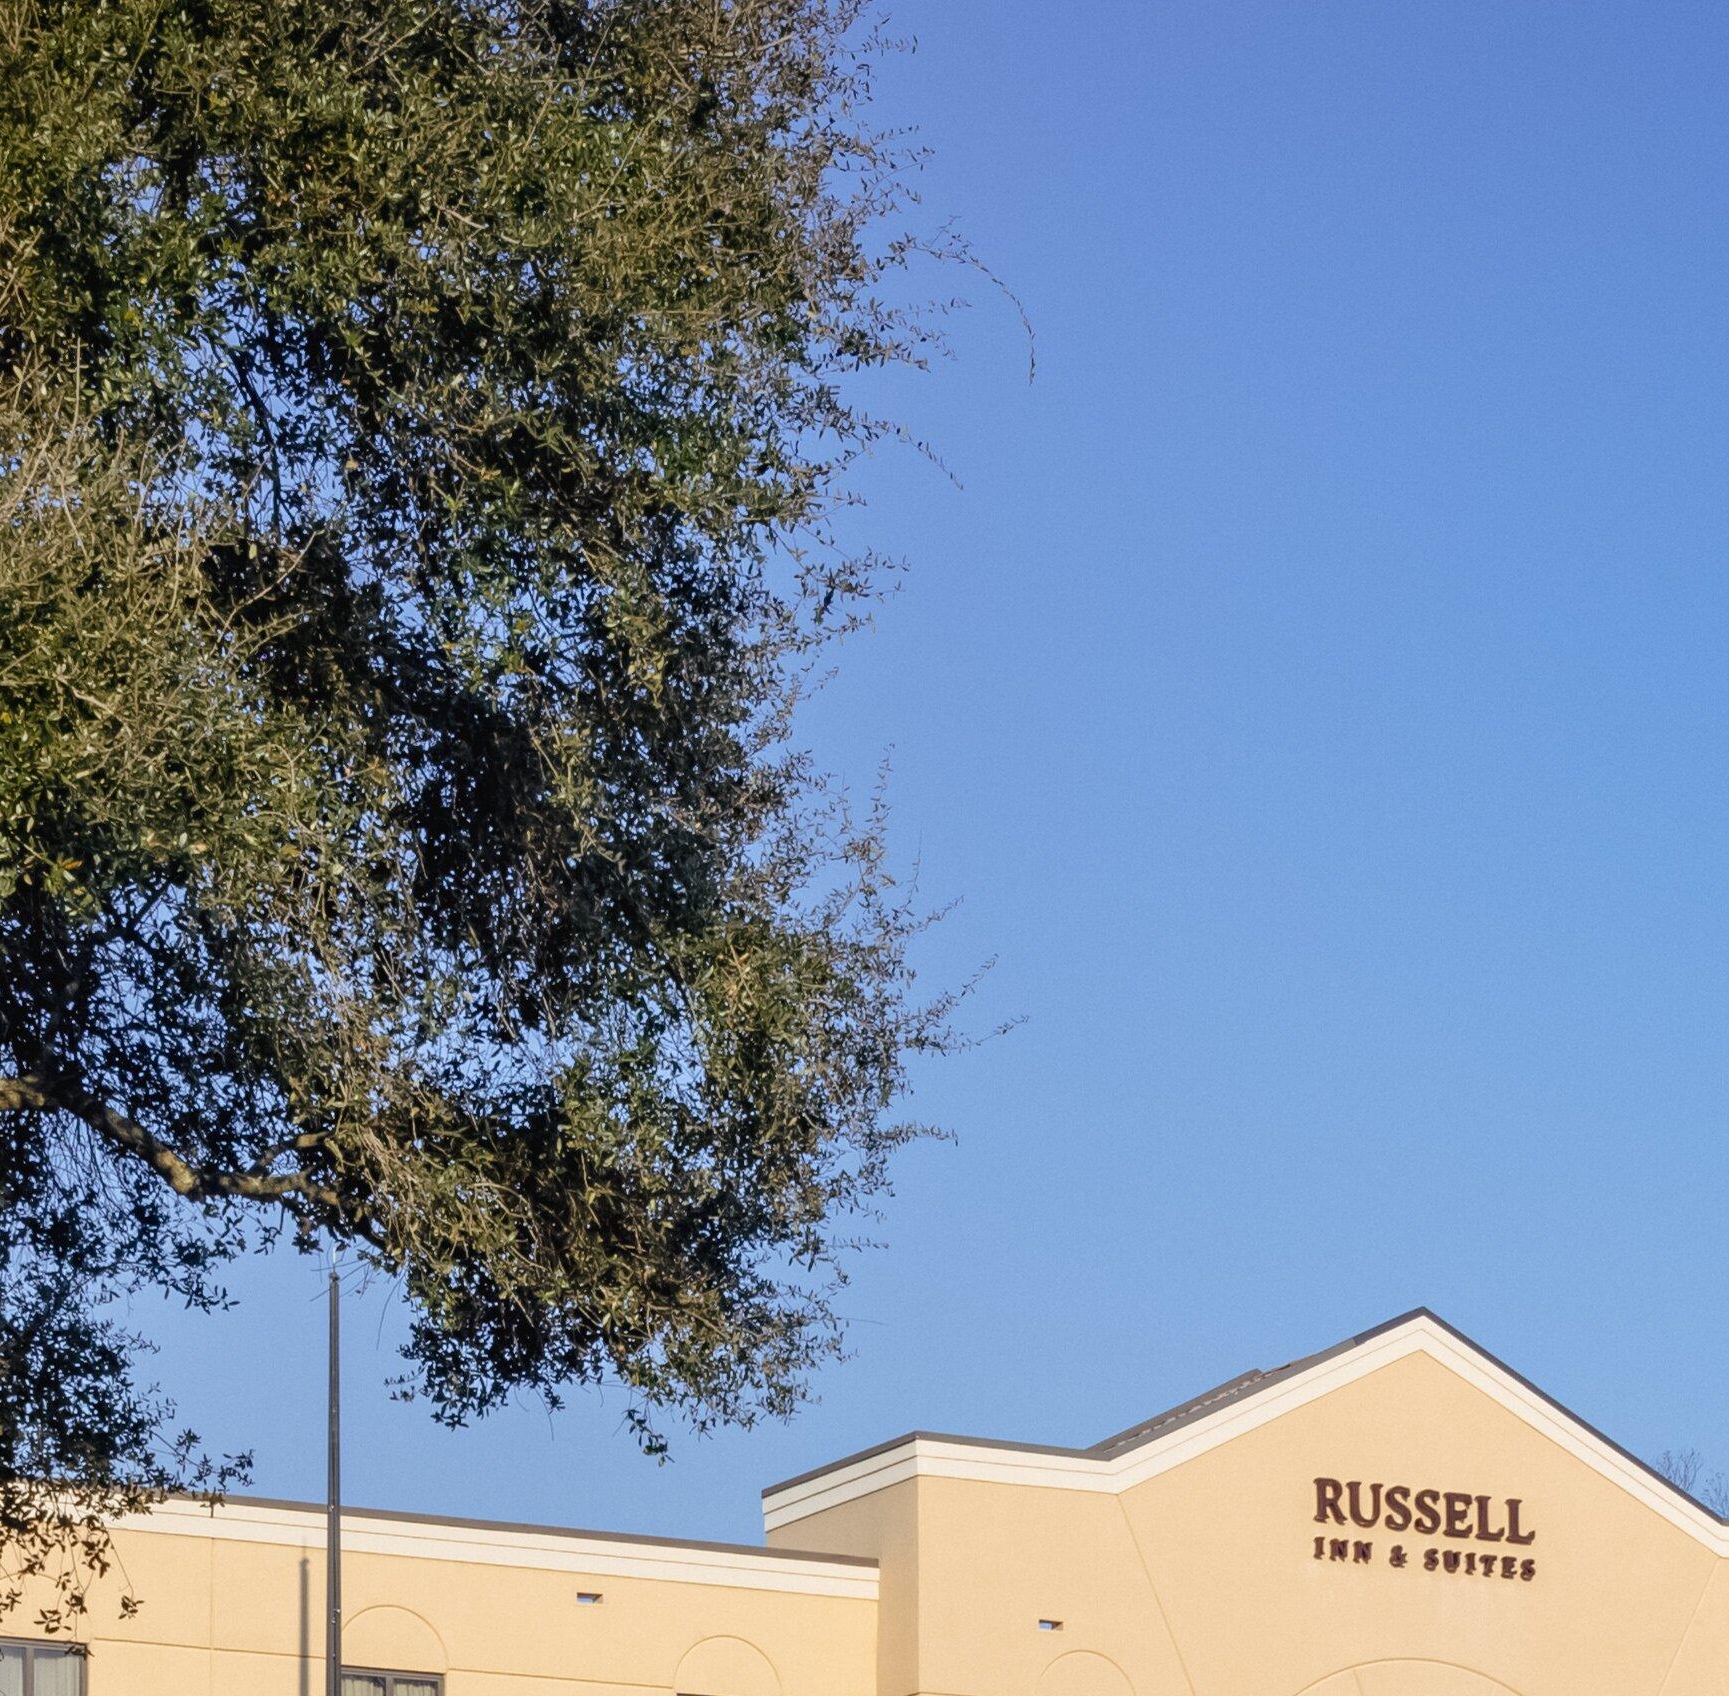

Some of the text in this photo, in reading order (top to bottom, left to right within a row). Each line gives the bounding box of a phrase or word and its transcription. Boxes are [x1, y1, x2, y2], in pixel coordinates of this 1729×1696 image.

[1313, 1477, 1535, 1545] RUSSELL
[1313, 1536, 1536, 1581] INN & SUITES
